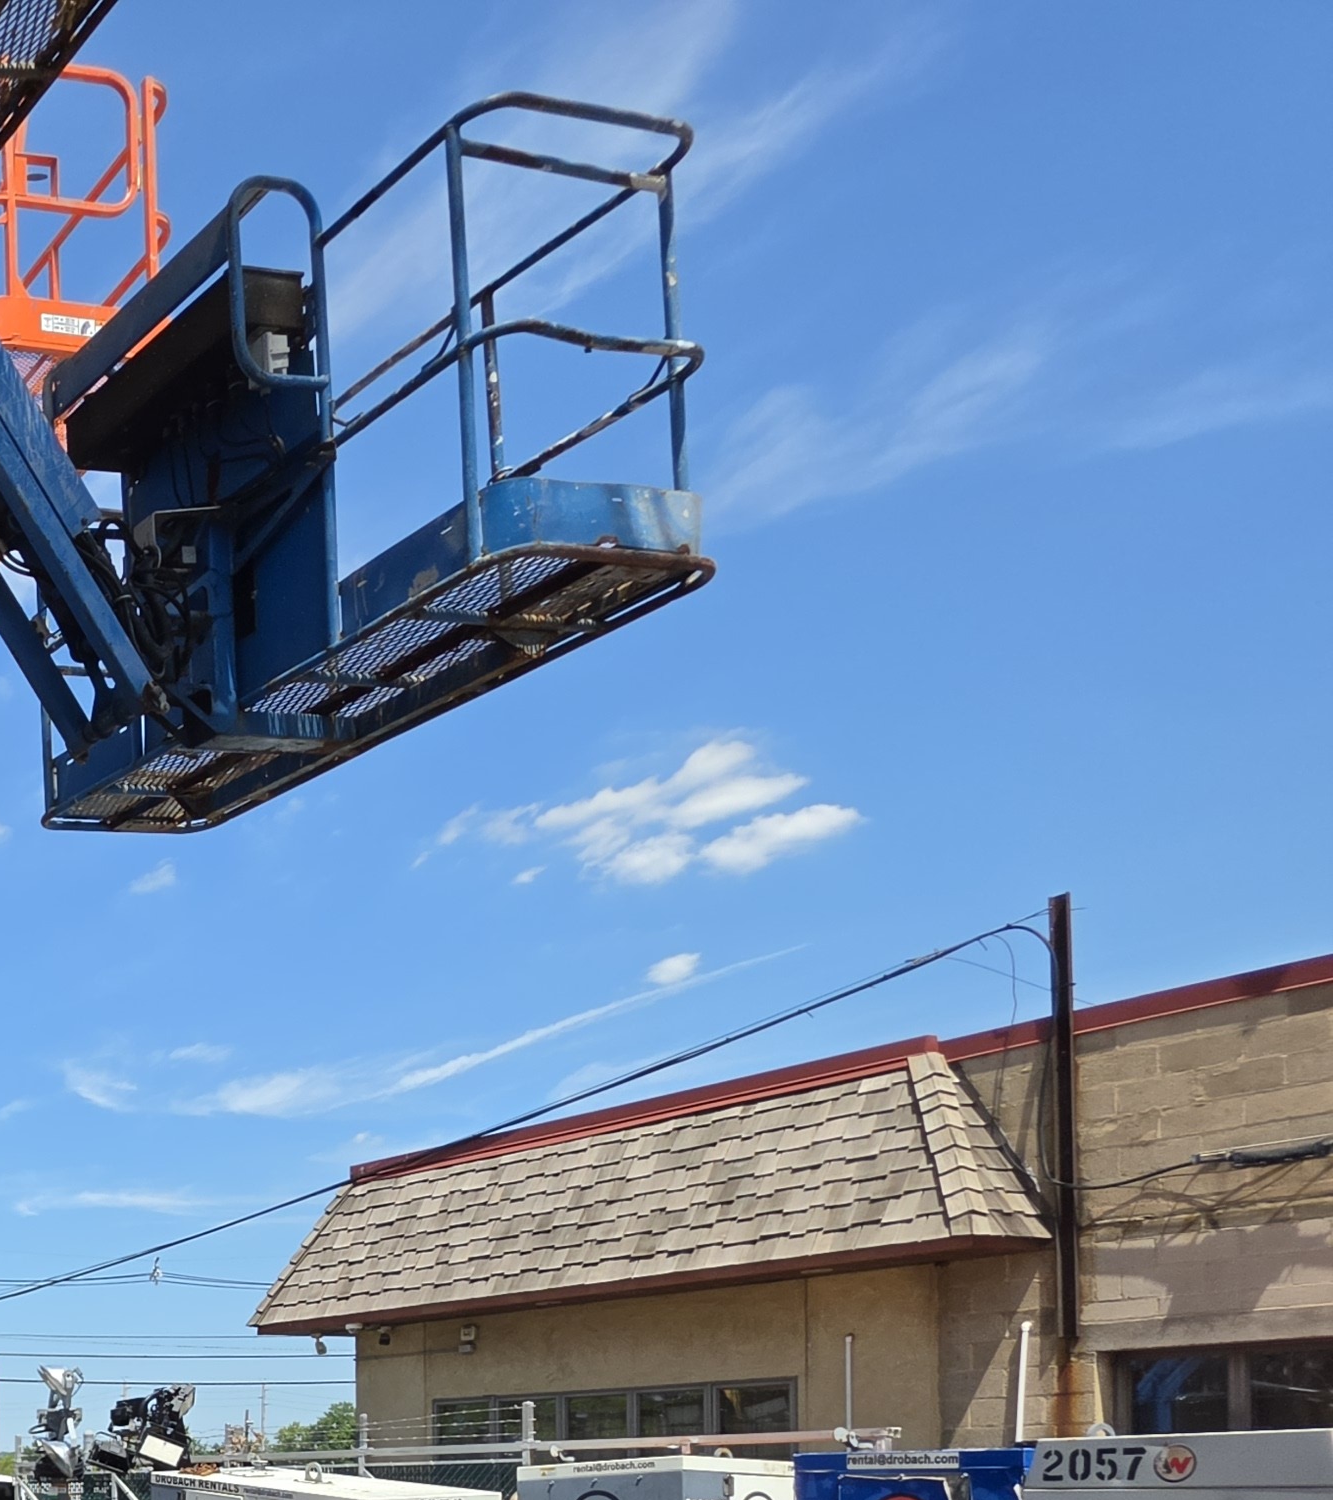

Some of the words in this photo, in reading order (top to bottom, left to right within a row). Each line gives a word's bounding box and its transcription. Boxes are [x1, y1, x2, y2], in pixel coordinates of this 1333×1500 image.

[573, 1460, 655, 1474] rental@drobach.com
[847, 1454, 959, 1466] rental@drobach.com
[1042, 1447, 1147, 1481] 2057
[155, 1475, 196, 1488] DROBACH
[199, 1480, 240, 1494] RENTALS
